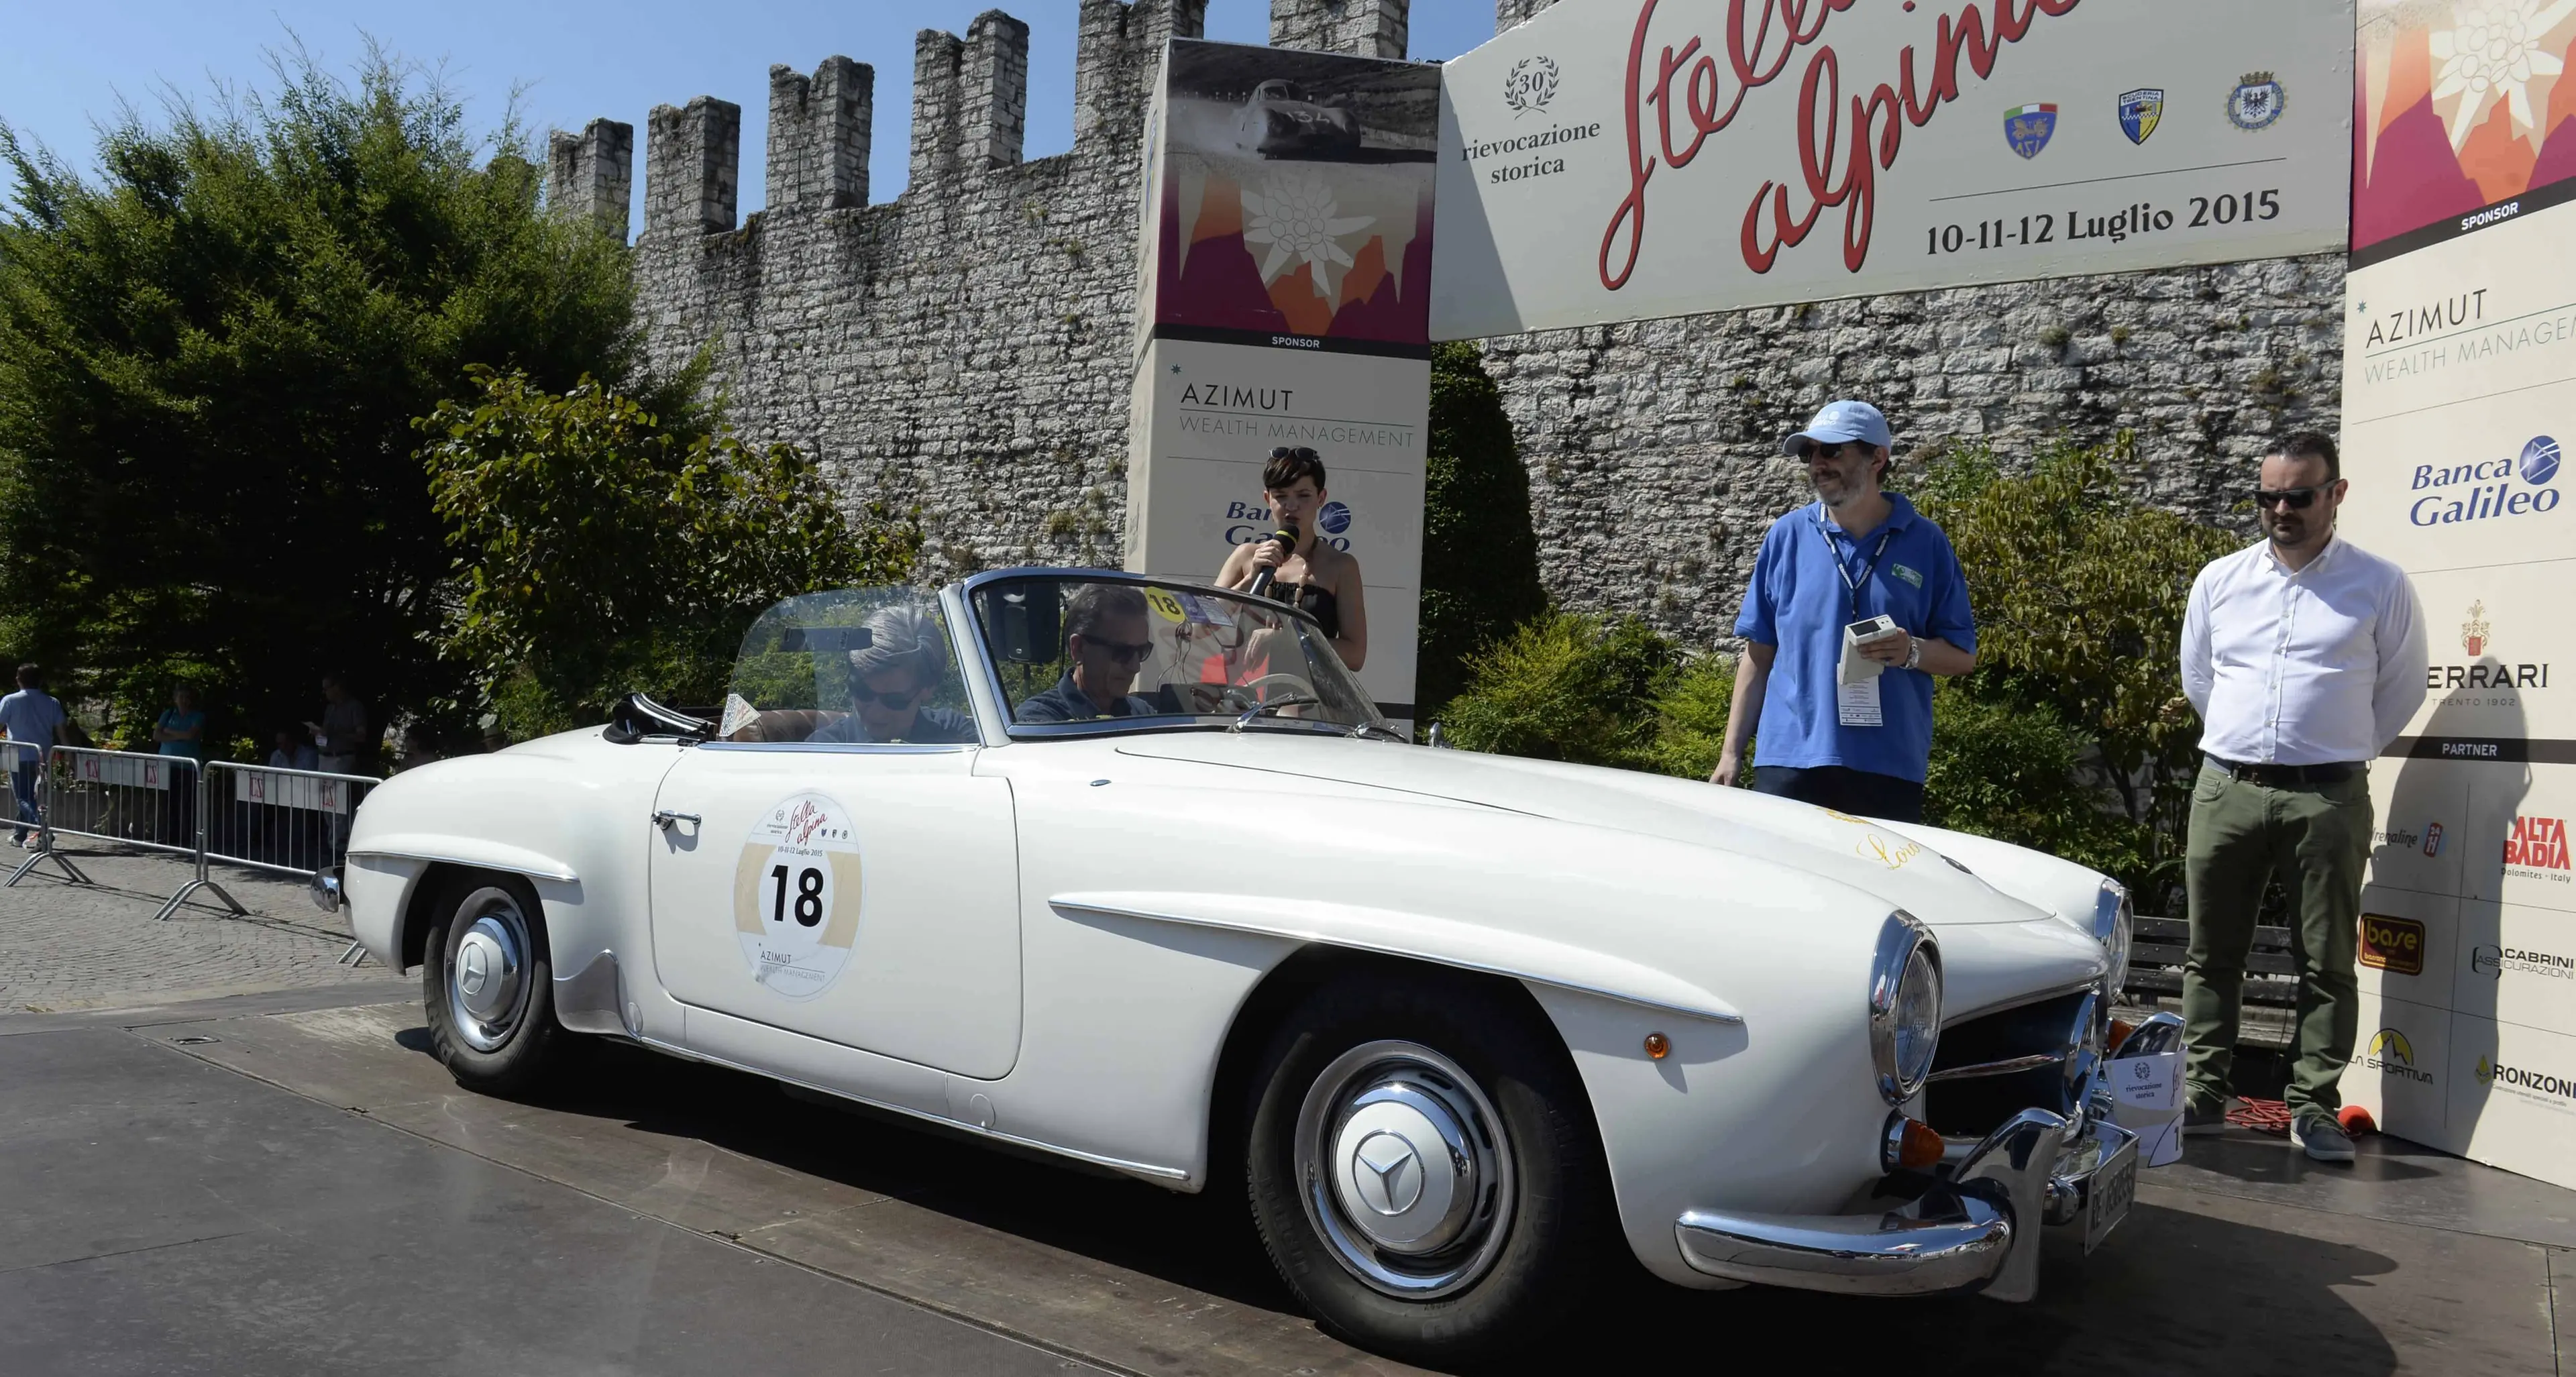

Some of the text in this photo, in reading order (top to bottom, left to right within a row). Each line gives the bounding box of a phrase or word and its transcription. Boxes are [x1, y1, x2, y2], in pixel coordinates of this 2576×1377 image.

[2122, 91, 2160, 101] SCUDERIA
[2122, 96, 2159, 105] TRENTINA
[1461, 122, 1601, 161] rievocazione
[1491, 156, 1565, 184] storica
[1927, 188, 2281, 256] 10-11-12 Luglio 2015
[2461, 201, 2520, 231] SPONSOR
[2366, 288, 2487, 349] AZIMUT
[1271, 336, 1320, 349] SPONSOR
[2365, 346, 2447, 384] WEALTH
[1180, 382, 1294, 411] AZIMUT
[1179, 415, 1415, 448] WEALTH MANAGEMENT
[2411, 458, 2513, 490] Banca
[2410, 482, 2561, 527] Galileo
[1149, 594, 1181, 615] 18
[2426, 663, 2549, 689] ERRARI
[2432, 697, 2516, 708] TRENTO 1902
[2442, 742, 2498, 757] PARTNER
[785, 800, 818, 843] Stella
[797, 814, 828, 846] alpina
[810, 849, 823, 857] 2015
[2502, 840, 2571, 870] BADIA
[2501, 867, 2542, 879] Dolomites
[2551, 873, 2571, 884] Italy
[771, 864, 824, 928] 18
[2367, 920, 2417, 950] base
[760, 950, 792, 965] AZIMUT
[2476, 955, 2573, 980] ASSICURAZIONI
[2505, 948, 2574, 969] CABRINI
[2367, 1058, 2433, 1085] SPORTIVA
[2126, 1083, 2162, 1093] rievocazione
[2135, 1091, 2155, 1099] storica
